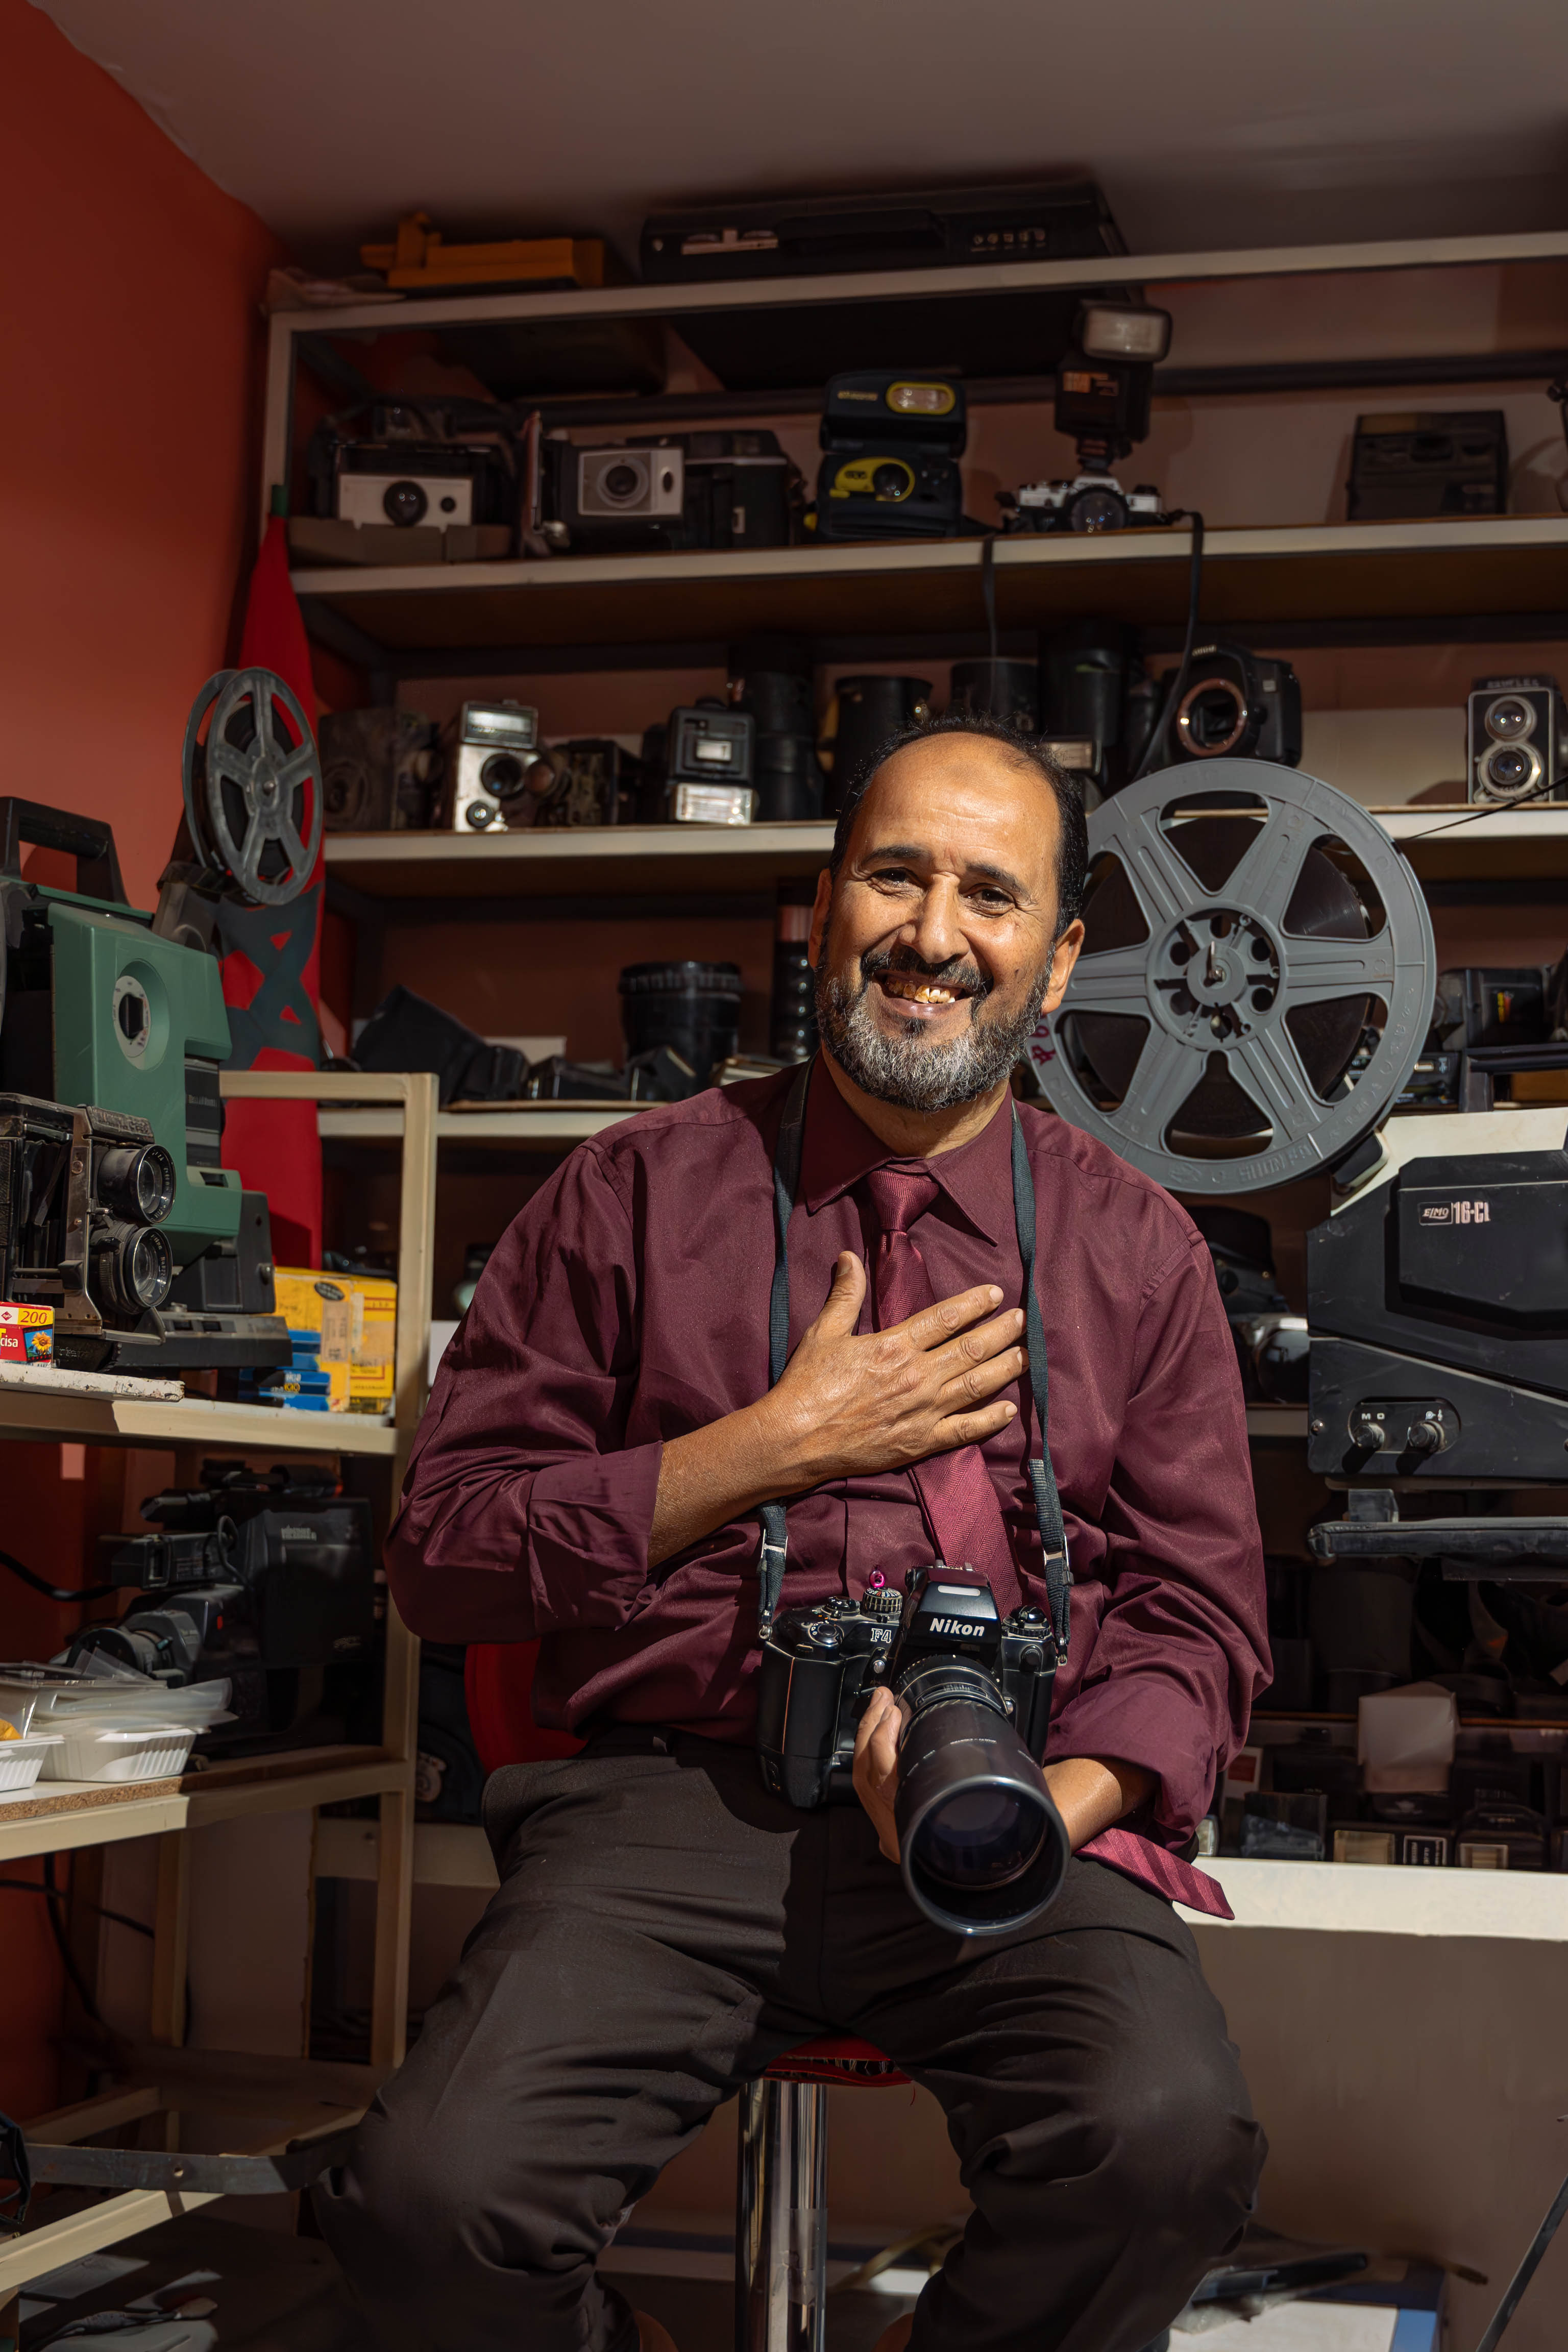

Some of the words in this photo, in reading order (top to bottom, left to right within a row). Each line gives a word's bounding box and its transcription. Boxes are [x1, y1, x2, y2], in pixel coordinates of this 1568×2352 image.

[1422, 1207, 1450, 1220] ELMO
[1453, 1200, 1491, 1224] 16-CL
[20, 1311, 47, 1324] 200
[0, 1335, 18, 1348] cisa
[870, 1627, 892, 1644] F4
[929, 1618, 985, 1637] Nikon
